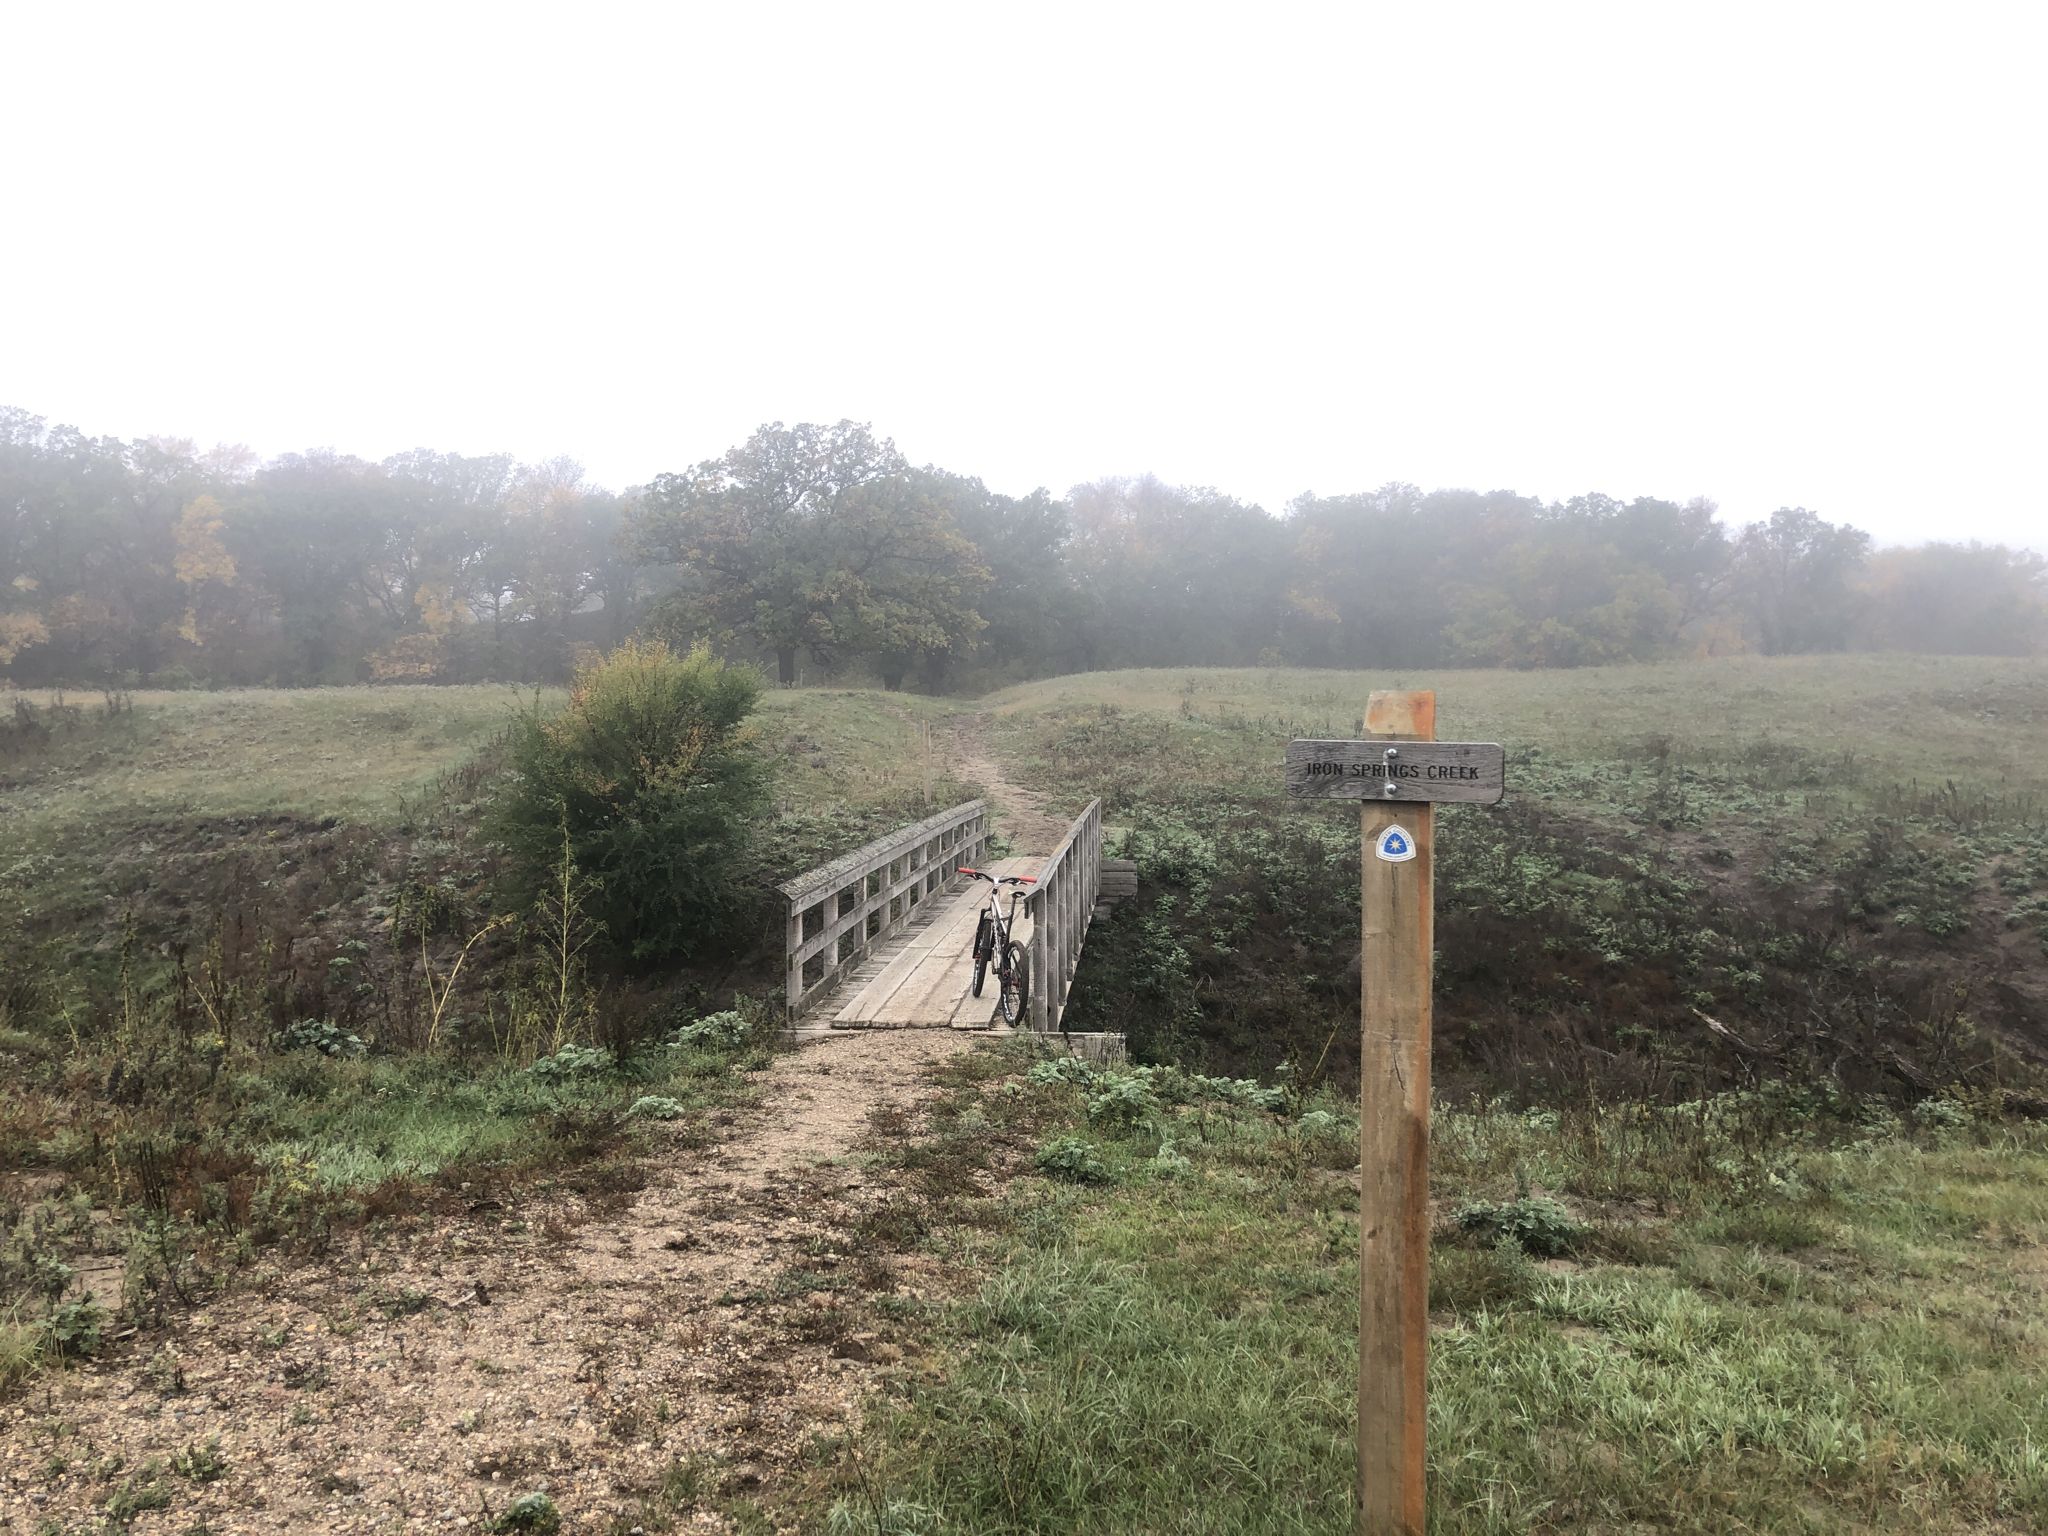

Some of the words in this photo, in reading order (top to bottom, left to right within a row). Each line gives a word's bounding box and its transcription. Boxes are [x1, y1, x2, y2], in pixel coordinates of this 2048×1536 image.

[1307, 762, 1343, 776] IRON
[1351, 763, 1419, 778] SPRINGS
[1427, 765, 1479, 780] CREEK
